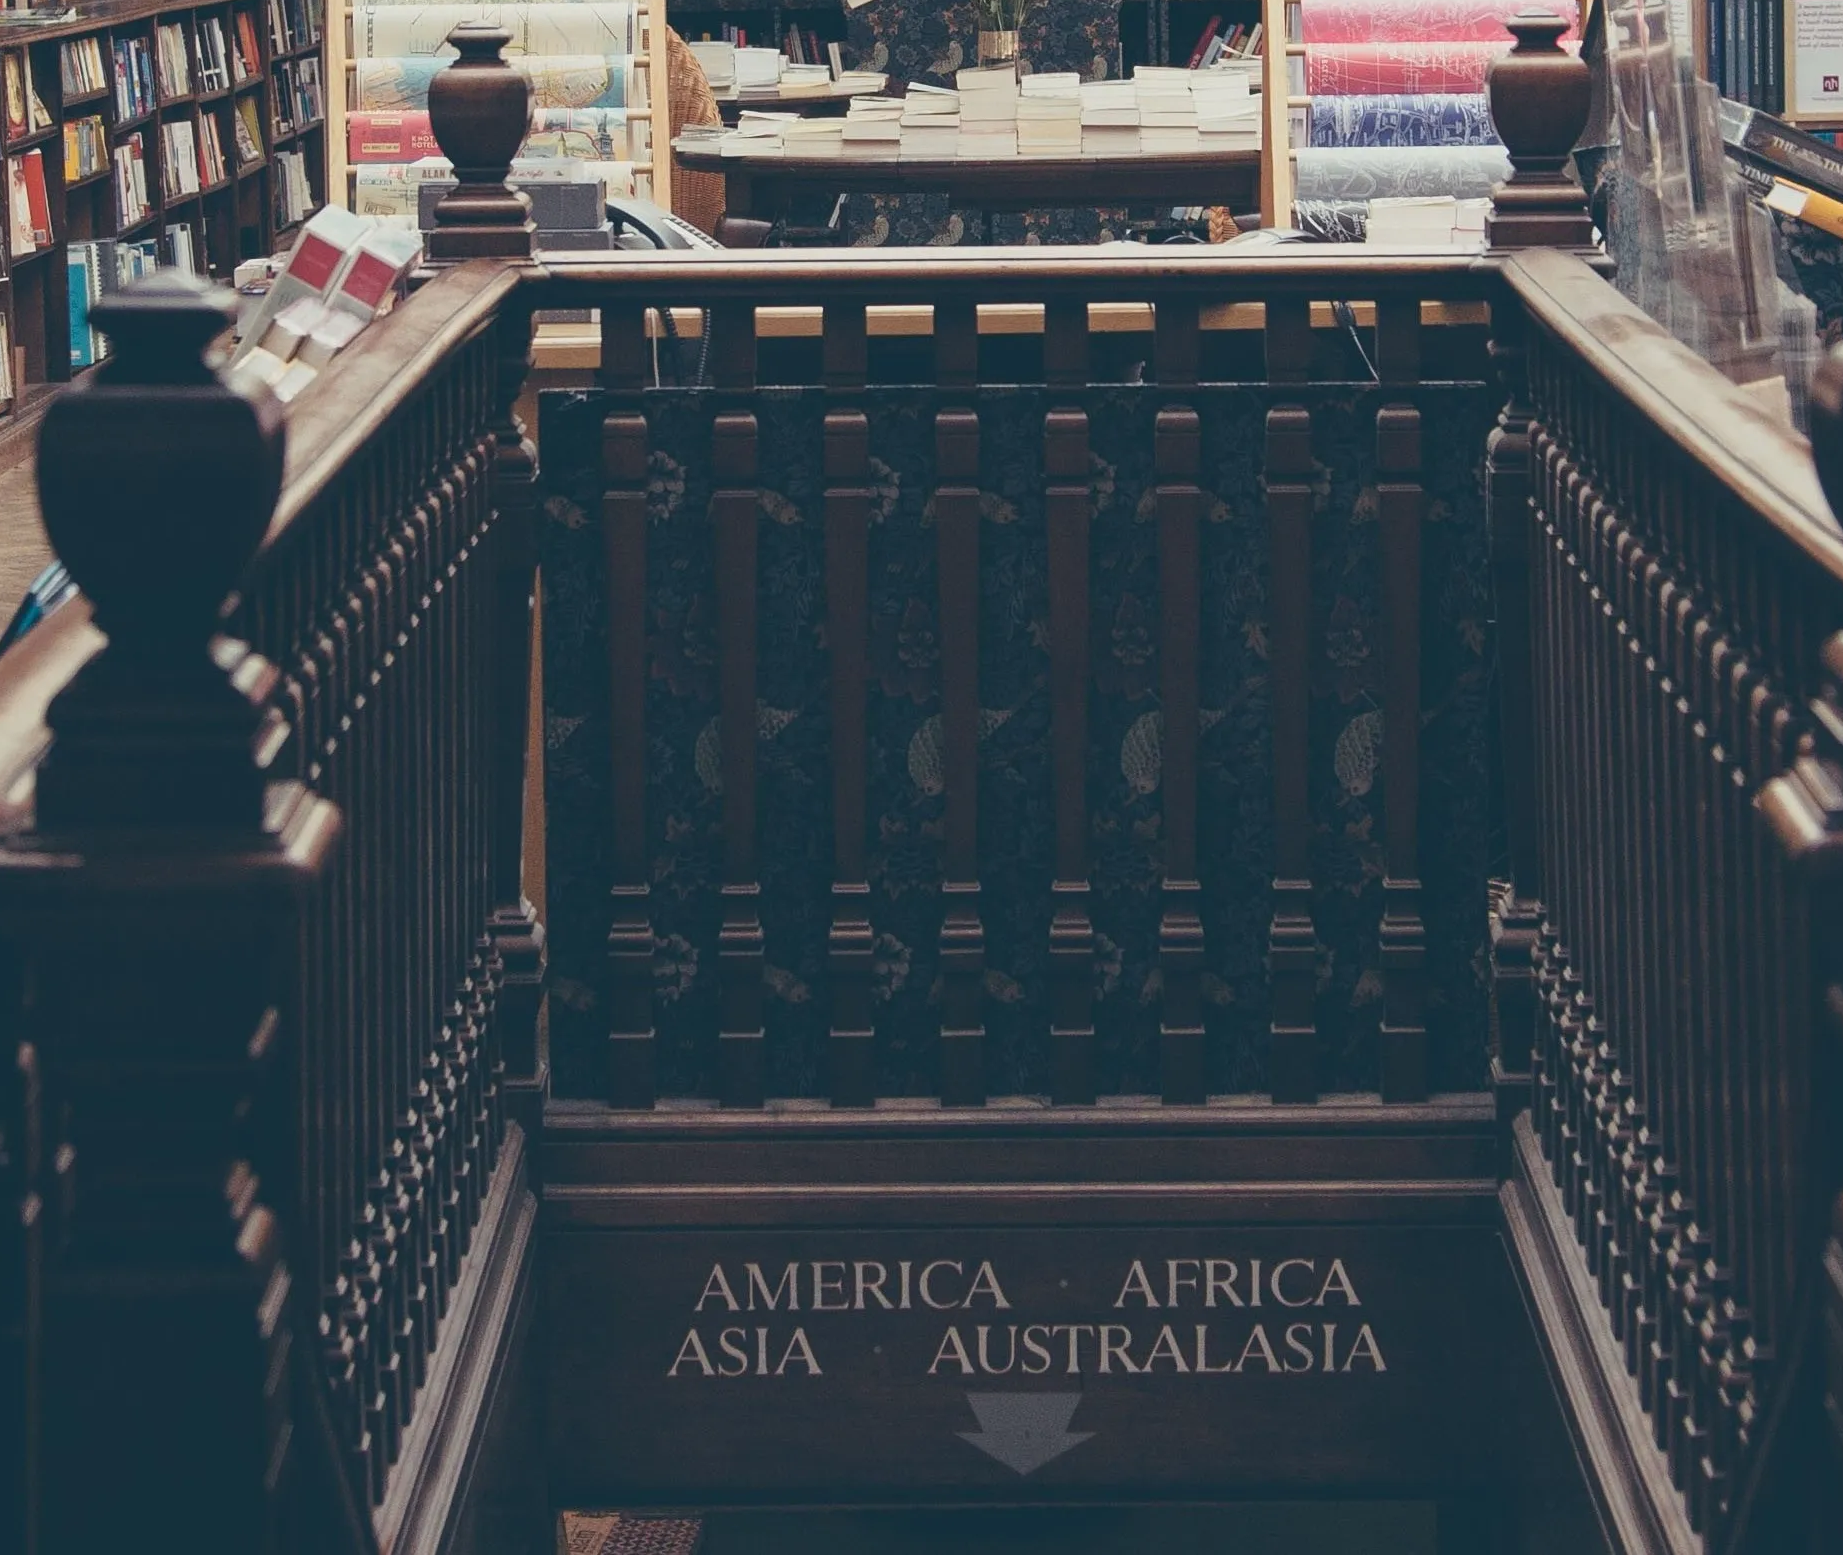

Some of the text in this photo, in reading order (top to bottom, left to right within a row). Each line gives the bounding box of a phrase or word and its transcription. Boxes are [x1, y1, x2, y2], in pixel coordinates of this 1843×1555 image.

[1772, 135, 1796, 152] THE
[422, 169, 446, 179] ALAN
[694, 1259, 1361, 1312] AMERICA AFRICA
[668, 1323, 1387, 1377] ASIA AUSTRALASIA
